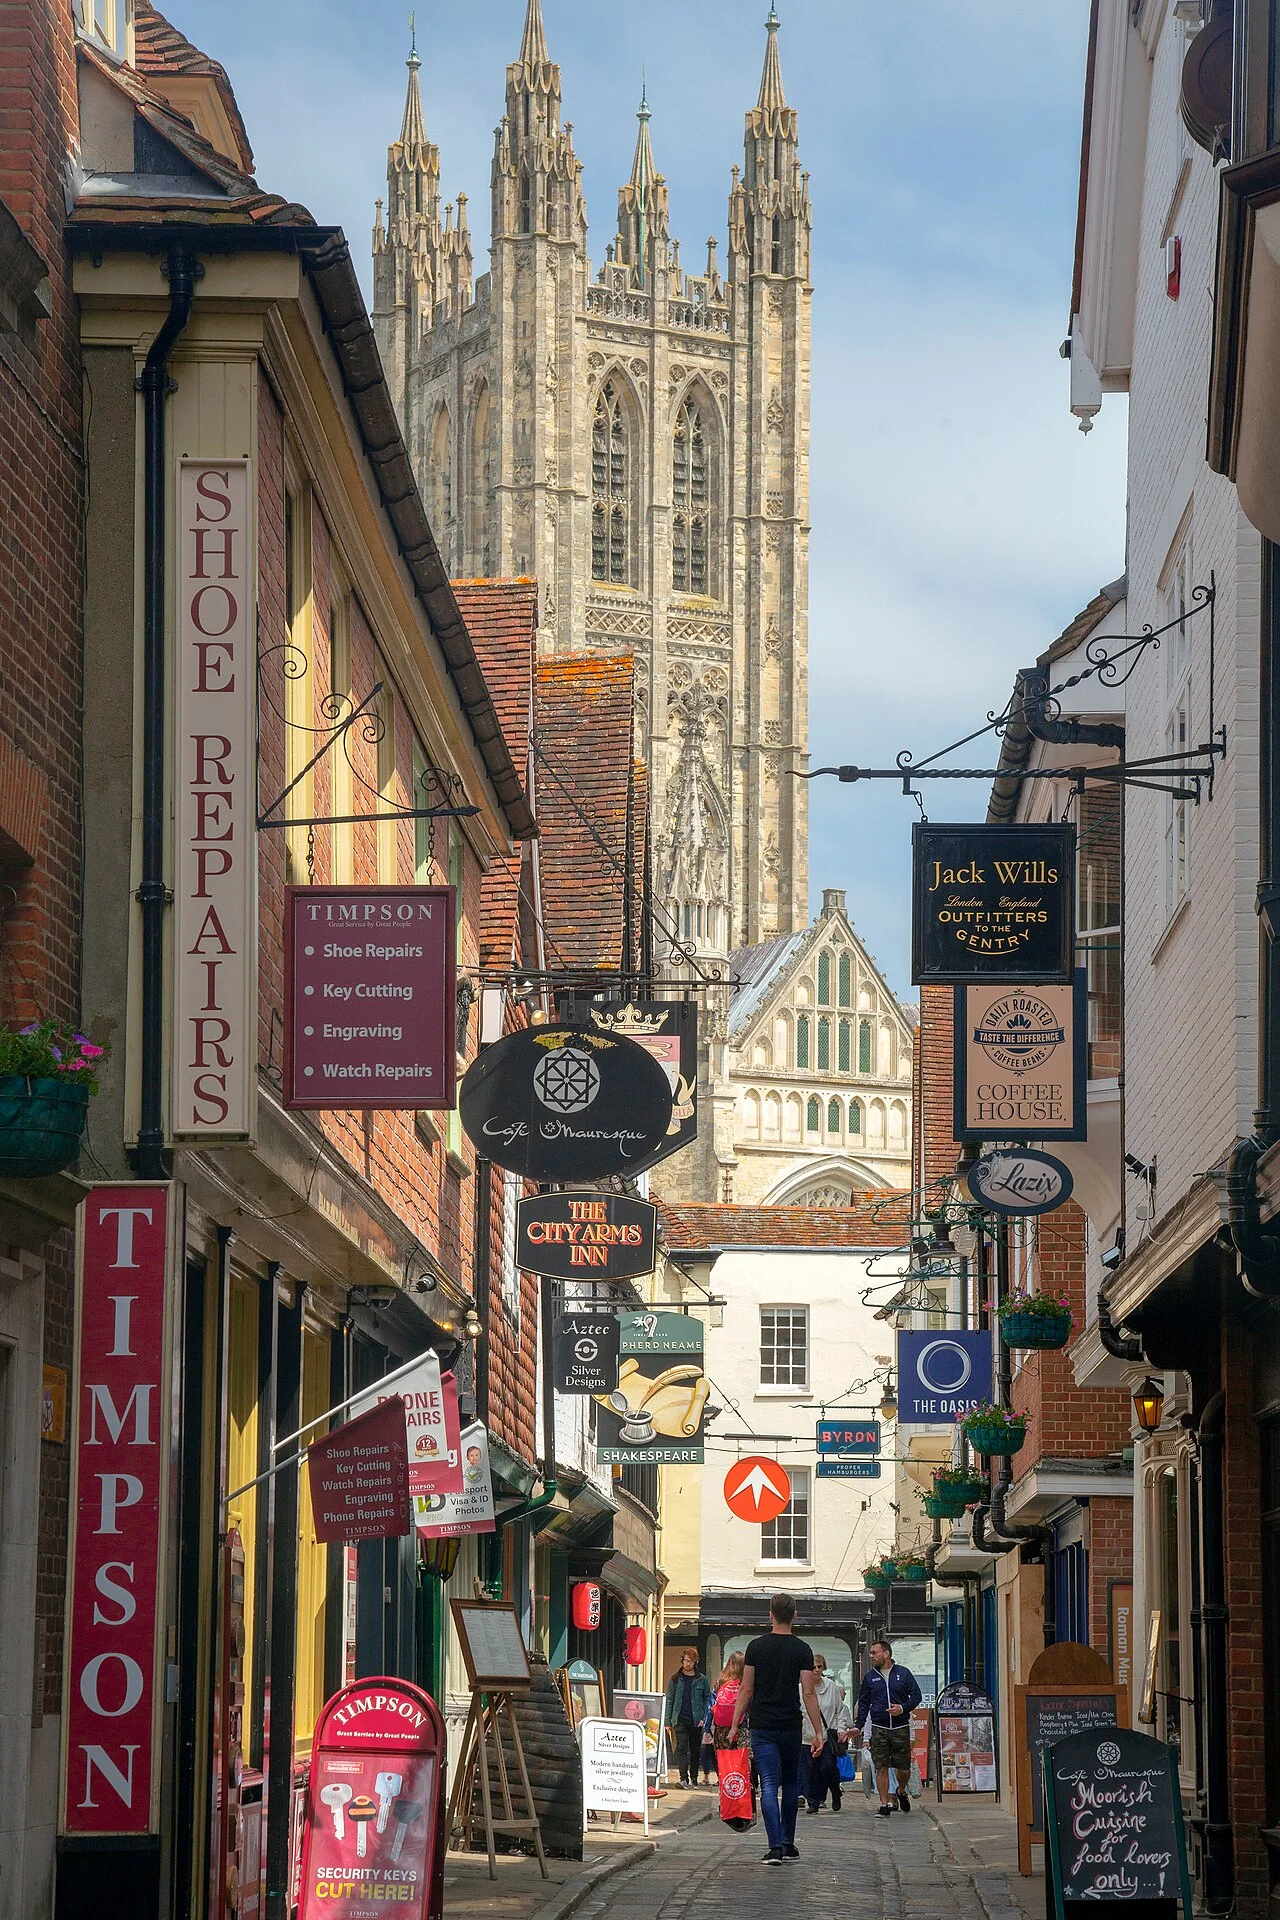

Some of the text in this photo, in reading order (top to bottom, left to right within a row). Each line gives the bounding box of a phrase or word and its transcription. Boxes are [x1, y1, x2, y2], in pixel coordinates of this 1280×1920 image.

[186, 469, 239, 1125] SHOE REPAIRS
[928, 860, 1058, 892] Jack Wills
[944, 894, 1043, 911] London England
[306, 904, 433, 920] TIMPSON
[938, 910, 1048, 923] OUTFITTERS
[367, 921, 375, 929] by
[392, 921, 412, 929] People
[955, 928, 1030, 949] GENTRY
[323, 943, 423, 960] Shoe Repairs
[323, 982, 413, 1001] Key Cutting
[985, 998, 1053, 1027] DAILY ROASTED
[323, 1023, 402, 1041] Engraving
[979, 1032, 1060, 1043] TASTE THE DIFFERENCE
[993, 1050, 1046, 1068] COFFEE BEANS
[322, 1063, 433, 1080] Watch Repairs
[977, 1084, 1062, 1100] COFFEE
[976, 1101, 1063, 1120] HOUSE
[482, 1115, 647, 1158] Café Mauresque
[989, 1162, 1057, 1204] Lazix
[568, 1200, 608, 1222] THE
[527, 1221, 643, 1246] CITY ARMS
[569, 1245, 608, 1266] INN
[562, 1320, 610, 1335] Aztec
[622, 1341, 702, 1350] PHERD NEAME
[571, 1365, 601, 1375] Silver
[565, 1376, 606, 1389] Designs
[377, 1391, 440, 1411] PONE
[913, 1400, 937, 1413] THE
[407, 1411, 441, 1427] AIRS
[421, 1439, 431, 1448] 12
[822, 1431, 876, 1443] BYRON
[326, 1444, 389, 1459] Shoe Repairs
[603, 1450, 697, 1461] SHAKESPEARE
[336, 1460, 391, 1475] Key Cutting
[323, 1477, 392, 1492] Watch Repairs
[345, 1491, 394, 1505] Engraving
[450, 1495, 489, 1506] Visa & ID
[76, 1208, 157, 1808] TIMPSON
[323, 1507, 395, 1523] Phone Repairs
[455, 1507, 485, 1515] Photos
[426, 1514, 443, 1522] PRO
[344, 1524, 386, 1535] TIMPSON
[439, 1524, 471, 1532] TIMPSON
[821, 1603, 833, 1612] 28
[1117, 1607, 1130, 1685] Roman Mus
[332, 1695, 427, 1728] TIMPSON
[1057, 1712, 1073, 1720] Bueno
[376, 1731, 383, 1739] by
[384, 1731, 400, 1739] Great
[401, 1732, 420, 1740] People
[600, 1732, 626, 1742] Aztec
[1040, 1728, 1067, 1736] Chocolate
[611, 1761, 639, 1769] handmade
[610, 1769, 634, 1778] jewellery
[1056, 1766, 1165, 1788] Café Mauresque
[592, 1784, 638, 1794] Exclusive designs
[1070, 1781, 1154, 1811] Moorish
[1073, 1811, 1147, 1840] Cuisine
[1101, 1831, 1128, 1852] for
[1071, 1841, 1172, 1876] food lovers
[316, 1867, 417, 1881] SECURITY KEYS
[315, 1881, 415, 1901] CUT HERE!
